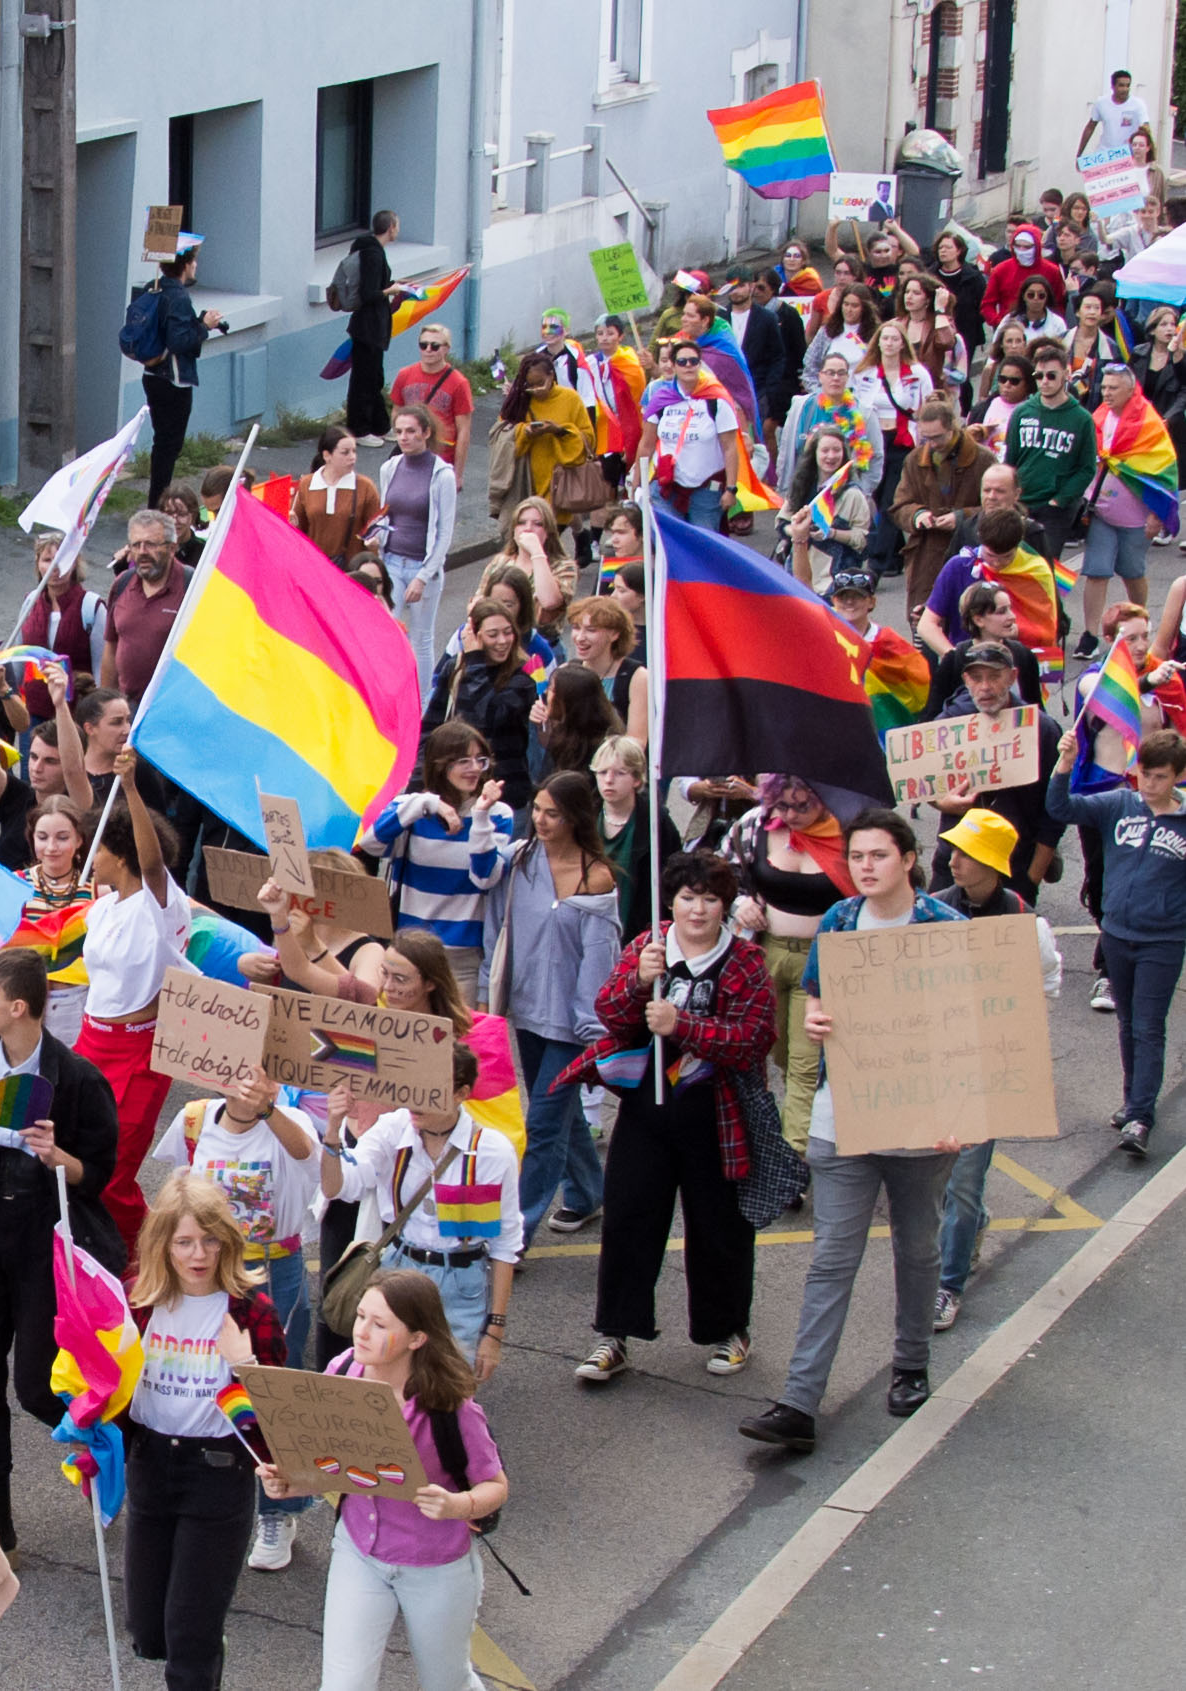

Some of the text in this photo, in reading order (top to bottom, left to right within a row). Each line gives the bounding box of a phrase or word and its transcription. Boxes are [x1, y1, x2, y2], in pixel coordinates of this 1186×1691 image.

[1019, 426, 1075, 454] CELTICS
[889, 715, 979, 765] LIBERTÉ
[942, 734, 1025, 770] EGALITÉ
[845, 934, 884, 969] JE
[994, 924, 1017, 947] LE
[827, 973, 871, 998] MOT
[201, 993, 260, 1030] droits
[321, 1002, 432, 1045] L'AMOUR
[191, 1048, 254, 1086] doigts
[145, 1332, 221, 1385] PROUD
[154, 1382, 172, 1396] KISS
[195, 1387, 219, 1399] WANT
[293, 1377, 355, 1405] elles
